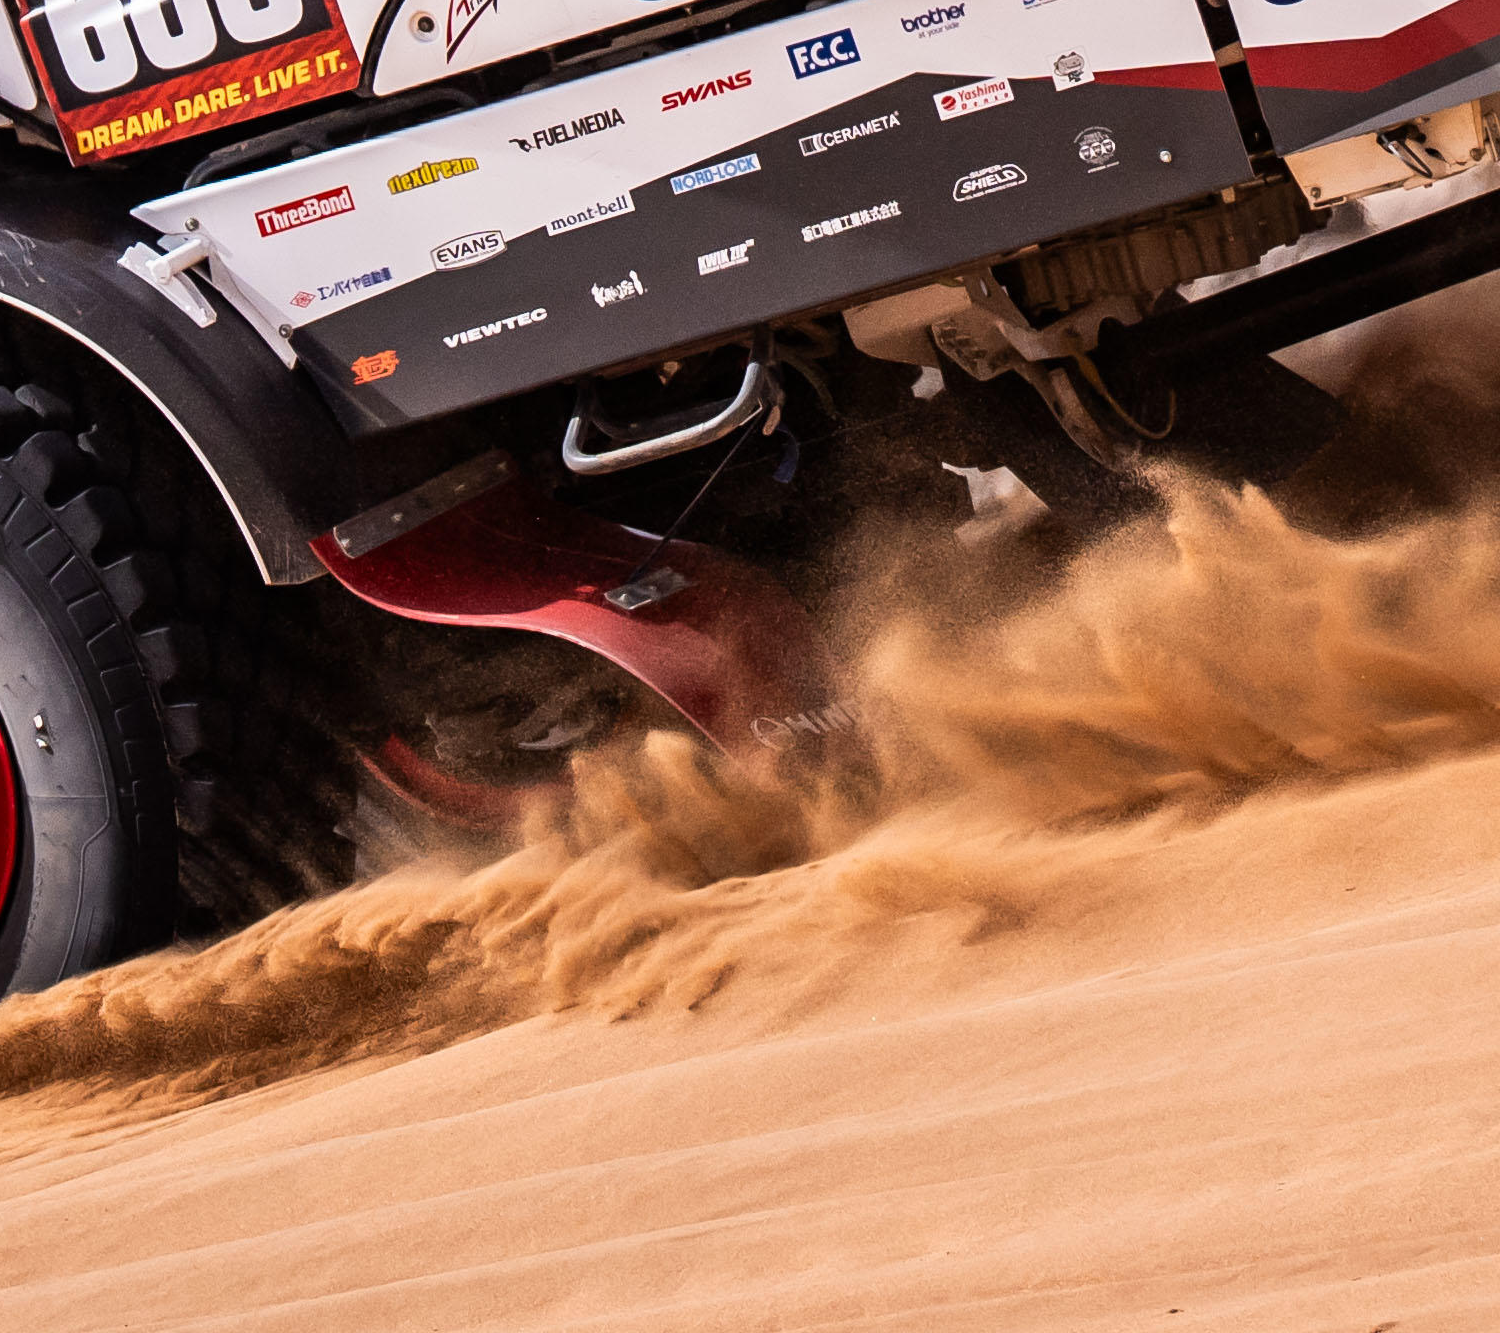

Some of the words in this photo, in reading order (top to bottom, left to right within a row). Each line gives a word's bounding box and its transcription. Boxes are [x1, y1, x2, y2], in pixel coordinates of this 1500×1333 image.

[901, 2, 965, 33] brother
[796, 37, 856, 75] F.C.C.
[75, 102, 172, 155] DREAM.
[174, 81, 250, 131] DARE.
[254, 58, 309, 100] LIVE
[312, 47, 348, 82] IT.
[661, 70, 752, 111] SWANS
[958, 81, 1006, 101] Yashima
[534, 108, 625, 150] FUELMEDIA
[823, 114, 900, 148] CERAMETA
[388, 157, 478, 195] flexdream
[673, 156, 758, 193] NORD-LOCK
[961, 170, 1018, 194] SHIELD
[259, 190, 350, 234] ThreeBond
[550, 195, 629, 232] mont-bell
[437, 233, 499, 263] EVANS
[443, 308, 547, 348] VIEWTEC
